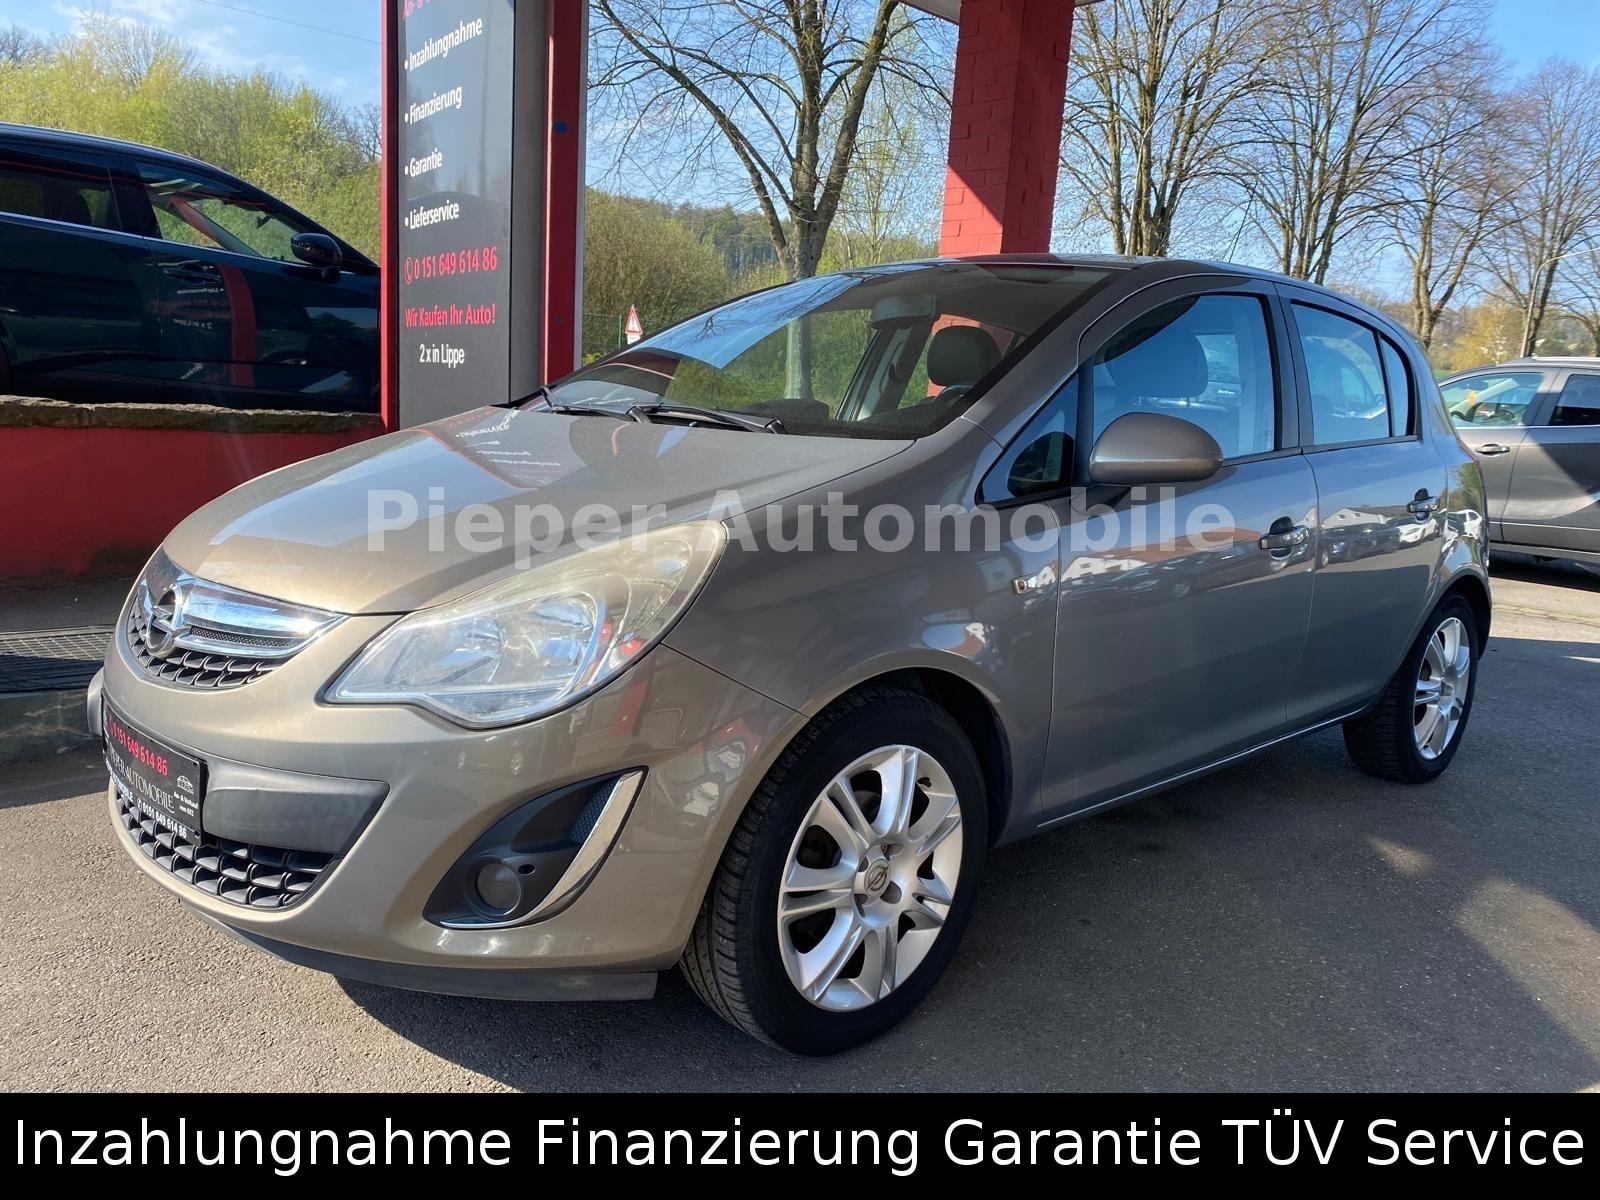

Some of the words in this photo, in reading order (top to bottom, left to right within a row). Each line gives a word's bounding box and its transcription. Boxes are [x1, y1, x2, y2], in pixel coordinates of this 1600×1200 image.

[409, 18, 483, 72] Inzahlungnahme
[409, 86, 463, 125] Finanzierung
[409, 148, 443, 178] Garantie
[409, 199, 460, 230] Lieferservice
[421, 255, 437, 279] 151
[438, 252, 457, 277] 649
[459, 248, 480, 274] 614
[482, 246, 498, 271] 86
[405, 306, 418, 328] Wir
[419, 304, 448, 327] Kaufen
[450, 303, 464, 325] Ihr
[465, 303, 496, 325] Auto!
[419, 343, 425, 363] 2
[432, 343, 440, 363] in
[441, 343, 465, 369] Lippe
[127, 735, 139, 758] 649
[140, 745, 155, 769] 614
[156, 756, 168, 776] 86
[124, 765, 175, 814] AUTOMOBILE
